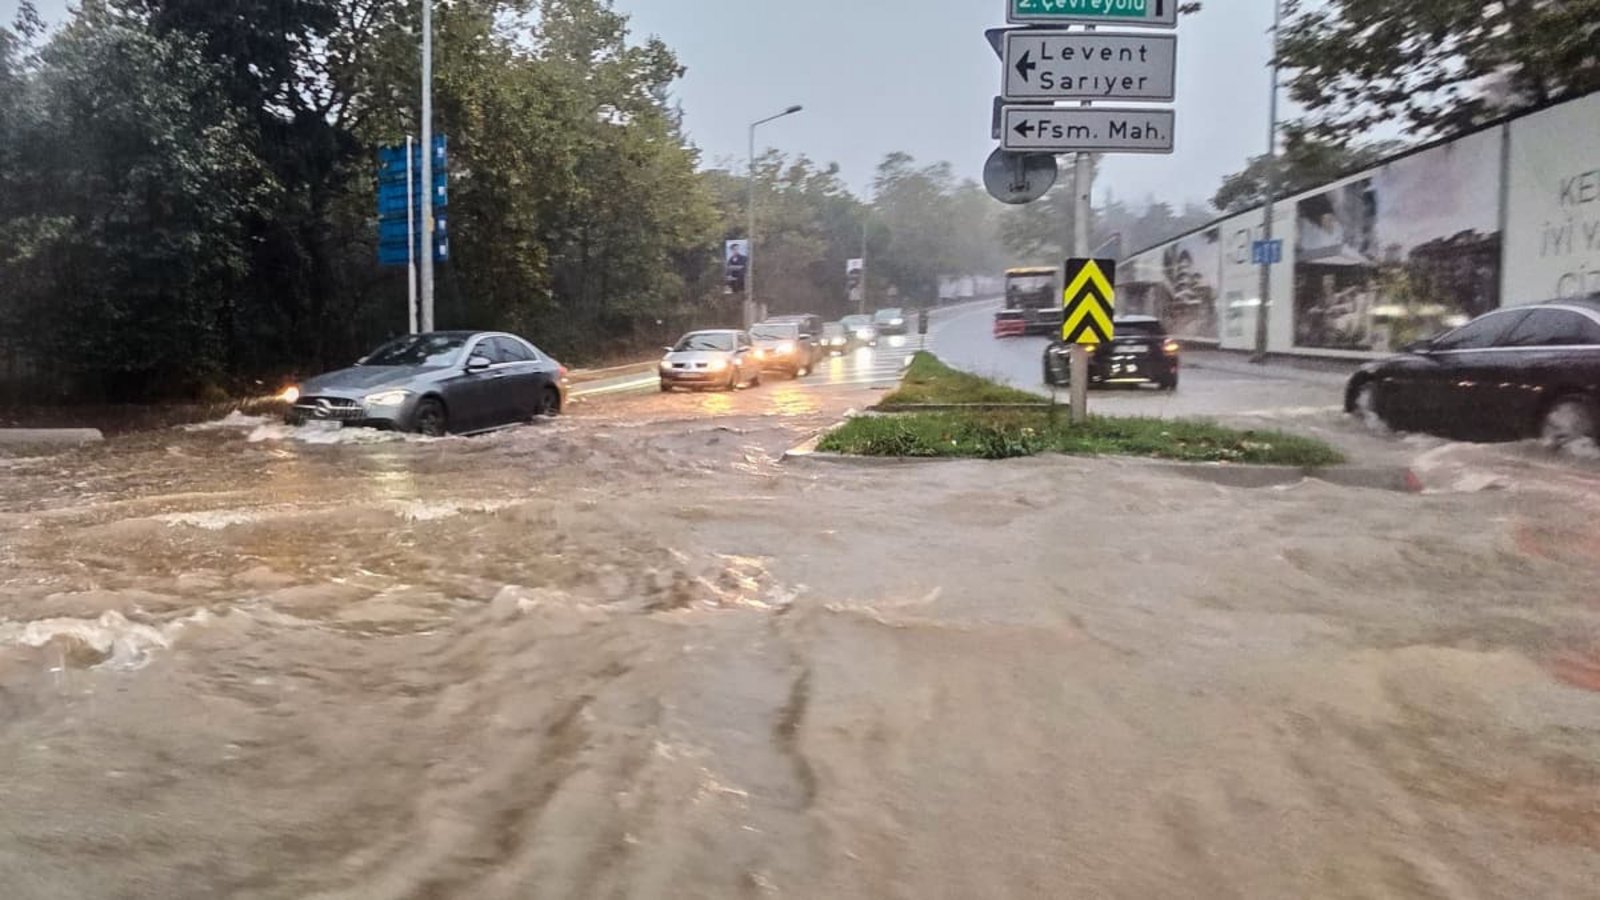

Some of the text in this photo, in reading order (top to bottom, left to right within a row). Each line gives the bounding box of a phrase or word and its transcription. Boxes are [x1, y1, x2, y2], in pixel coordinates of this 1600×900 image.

[1041, 41, 1148, 62] Levent
[1040, 71, 1148, 95] Sarıyer
[1038, 120, 1166, 140] Fsm. Mah.
[1560, 170, 1600, 206] KE
